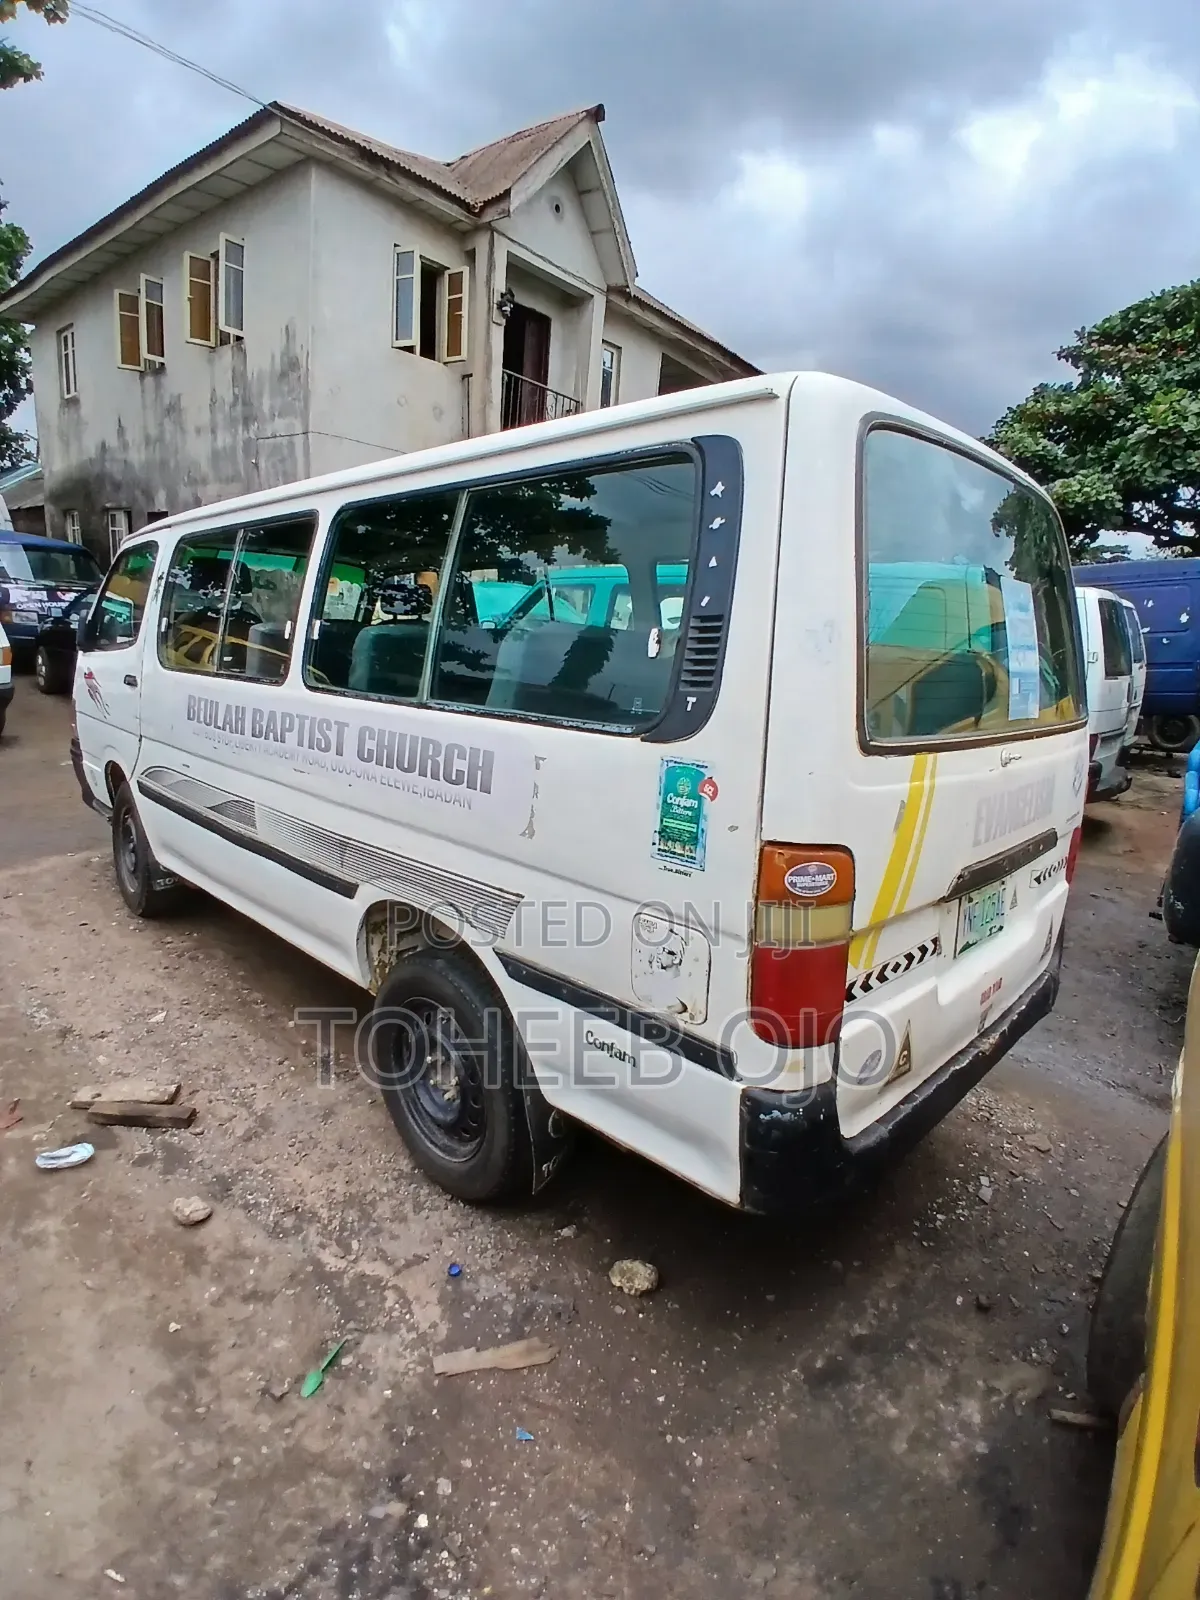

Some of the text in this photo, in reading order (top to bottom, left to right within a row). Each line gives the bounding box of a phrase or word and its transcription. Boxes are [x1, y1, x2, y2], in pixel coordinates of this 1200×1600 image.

[16, 602, 41, 610] OPEN
[186, 694, 495, 795] BEULAH BAPTIST CHURCH
[667, 792, 699, 809] Confam
[585, 1030, 637, 1068] Confam
